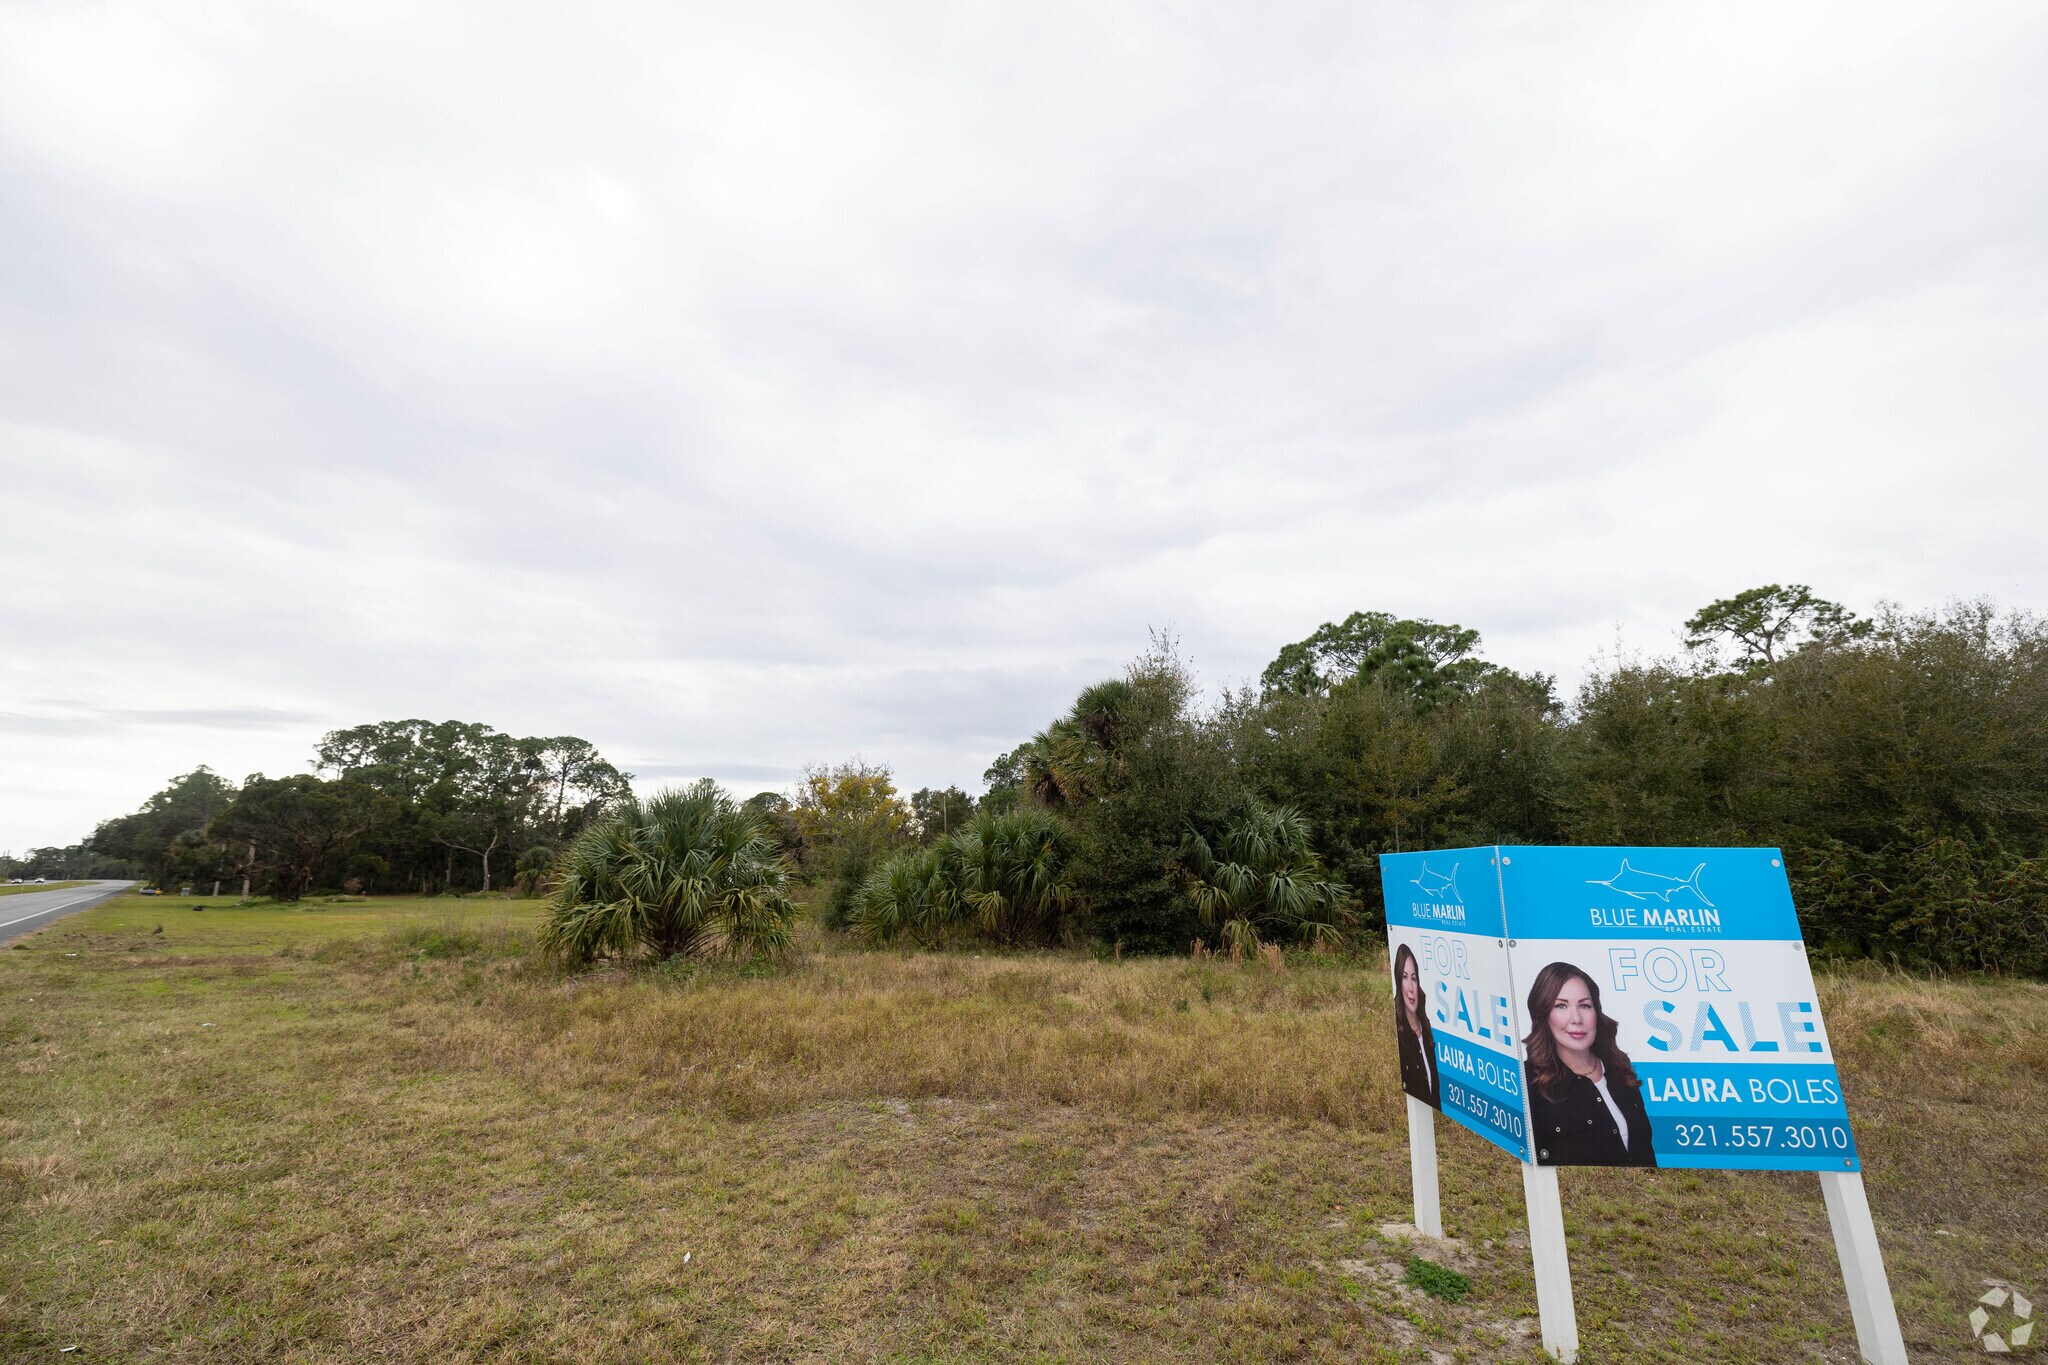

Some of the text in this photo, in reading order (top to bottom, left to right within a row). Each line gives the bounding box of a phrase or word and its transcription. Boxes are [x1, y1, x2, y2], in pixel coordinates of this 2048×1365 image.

[1412, 902, 1465, 920] BLUE MARLIN
[1590, 908, 1721, 926] BLUE MARLIN
[1420, 935, 1471, 980] FOR
[1608, 947, 1732, 993] FOR
[1434, 980, 1512, 1047] SALE
[1643, 1000, 1824, 1053] SALE
[1437, 1041, 1519, 1097] LAURA BOLES
[1647, 1078, 1839, 1105] LAURA BOLES
[1448, 1083, 1522, 1138] 321.557.3010
[1675, 1124, 1848, 1149] 321.557.3010
